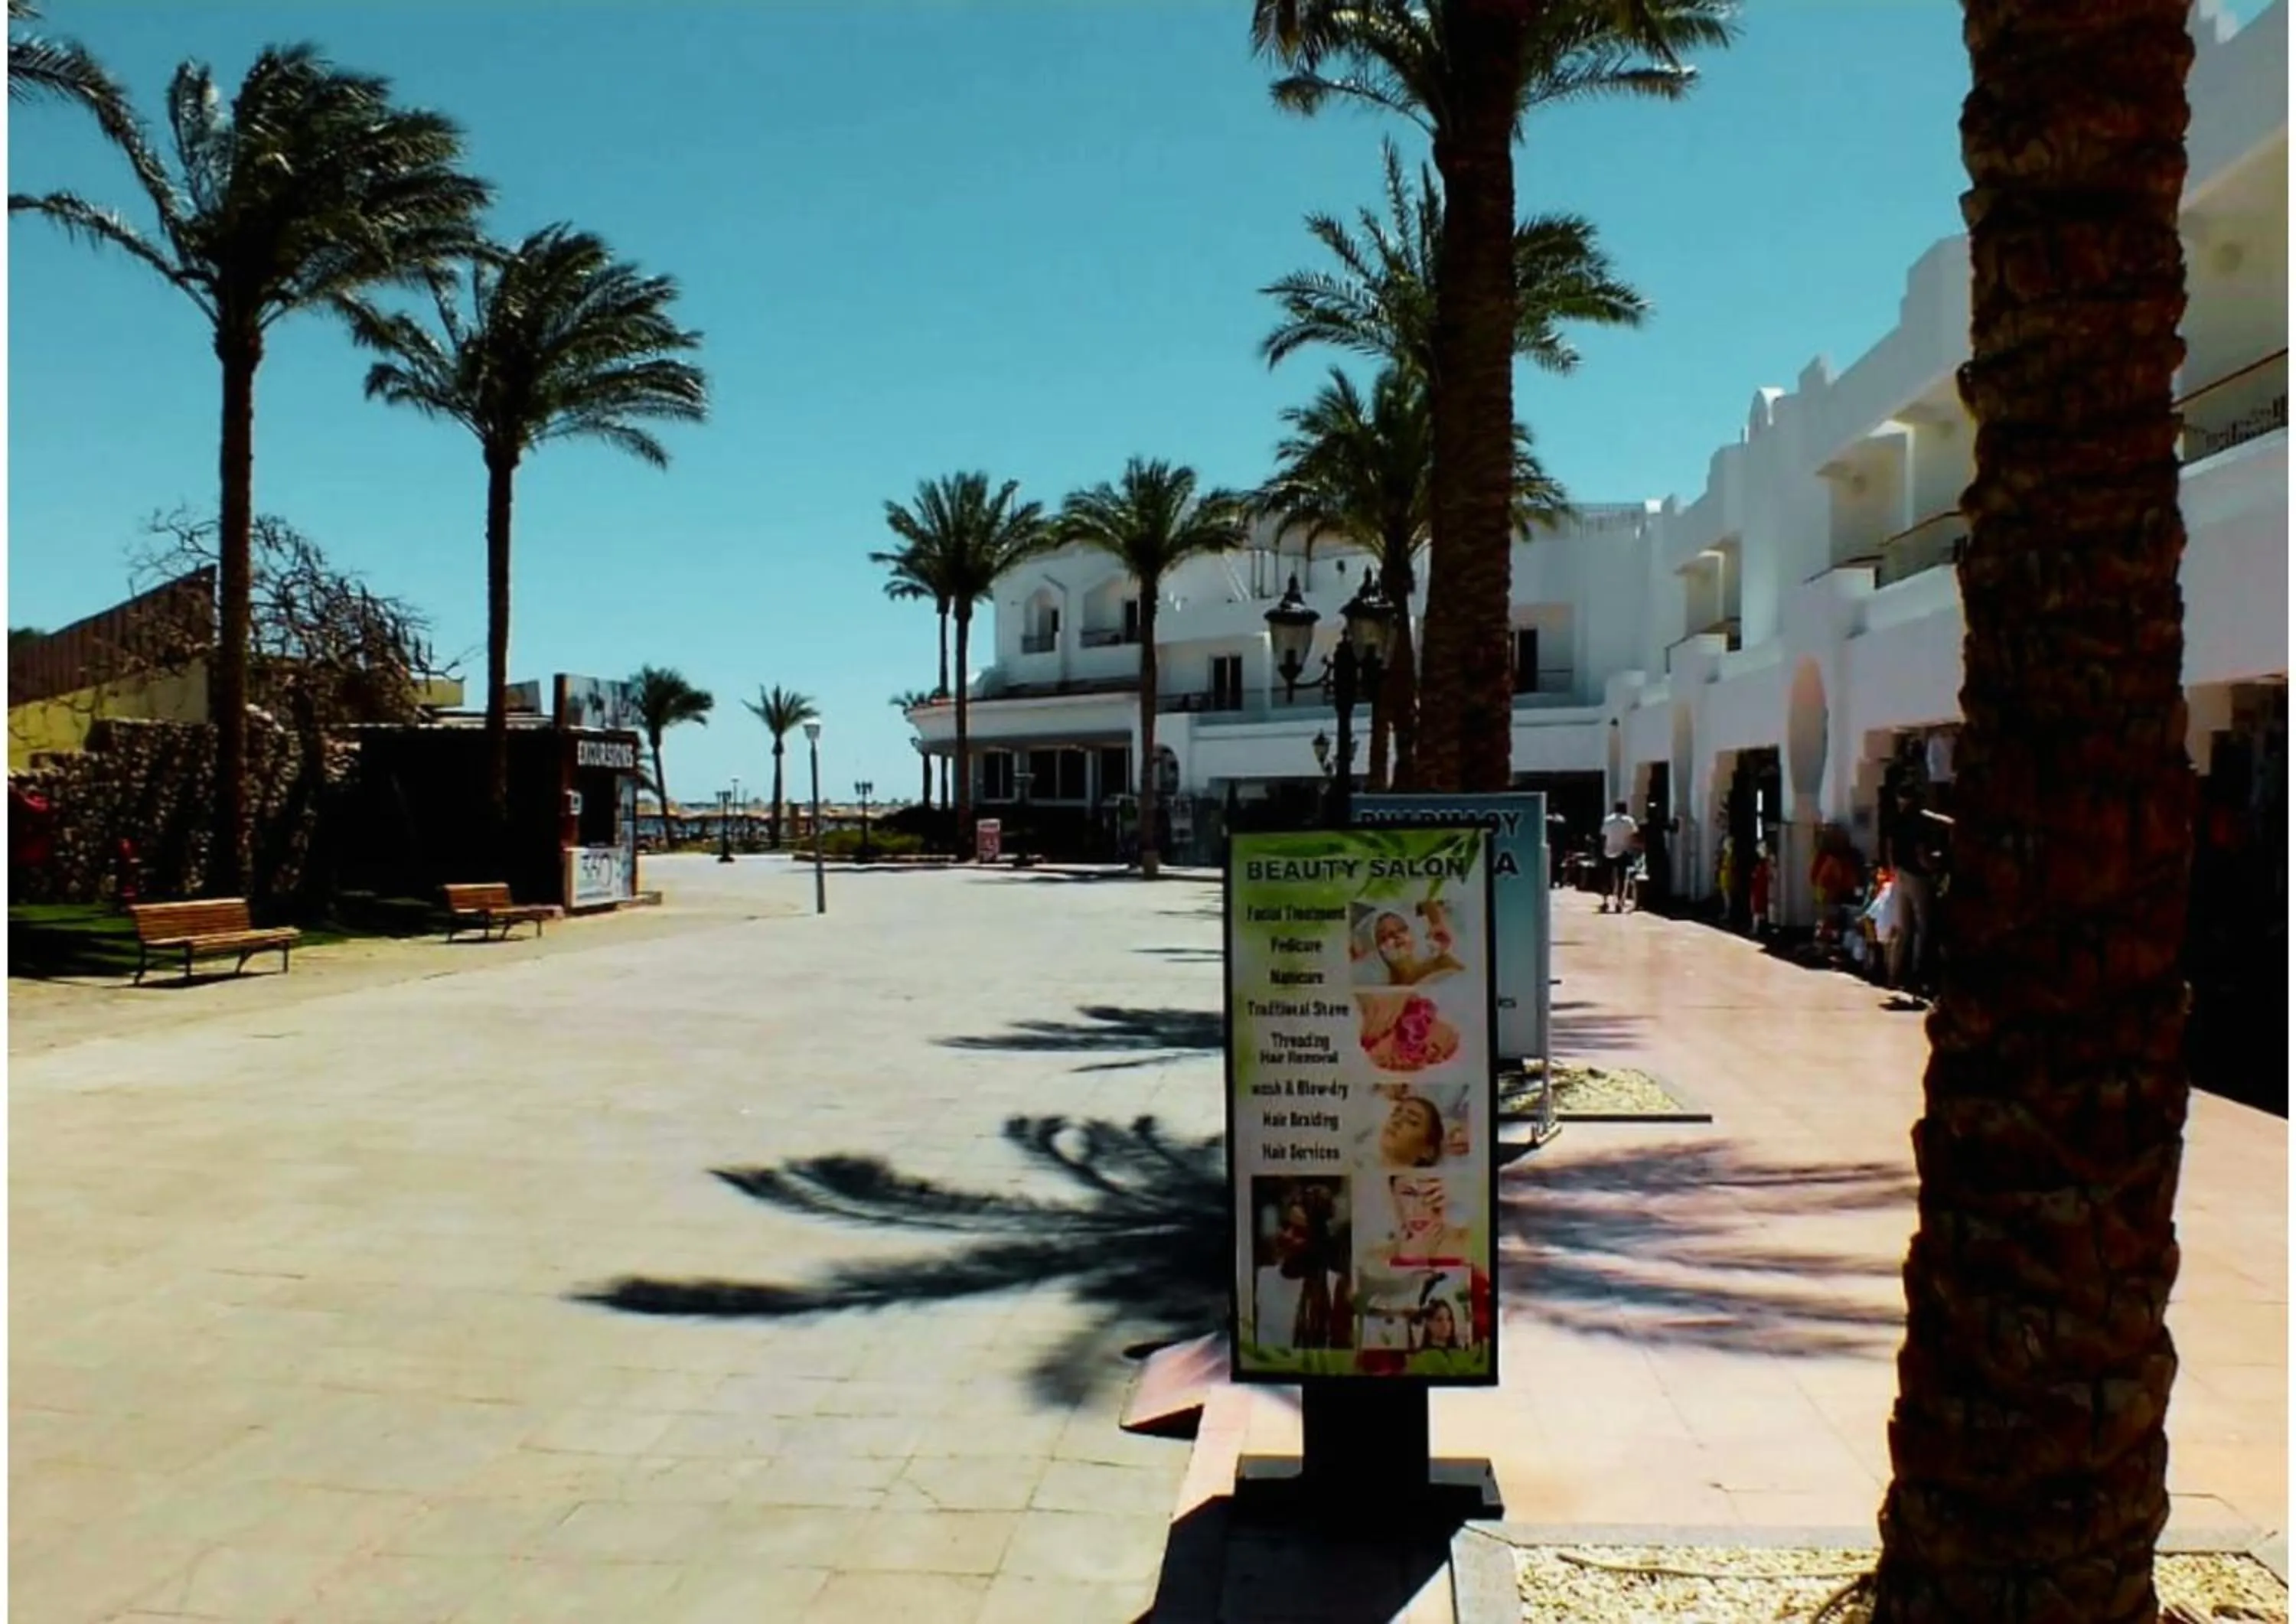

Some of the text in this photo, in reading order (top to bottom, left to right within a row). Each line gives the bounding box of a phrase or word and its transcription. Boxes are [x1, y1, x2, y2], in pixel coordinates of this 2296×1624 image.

[578, 740, 633, 767] EXCURSIONS
[1246, 857, 1464, 880] BEAUTY SALON
[1247, 904, 1346, 921] Facial Treatment
[1247, 1000, 1349, 1017] Traditional Shave
[1270, 1032, 1330, 1052] Threading
[1259, 1049, 1339, 1065] Hair Removal
[1262, 1110, 1339, 1132] Hair Braiding
[1262, 1142, 1341, 1160] Hair Services
